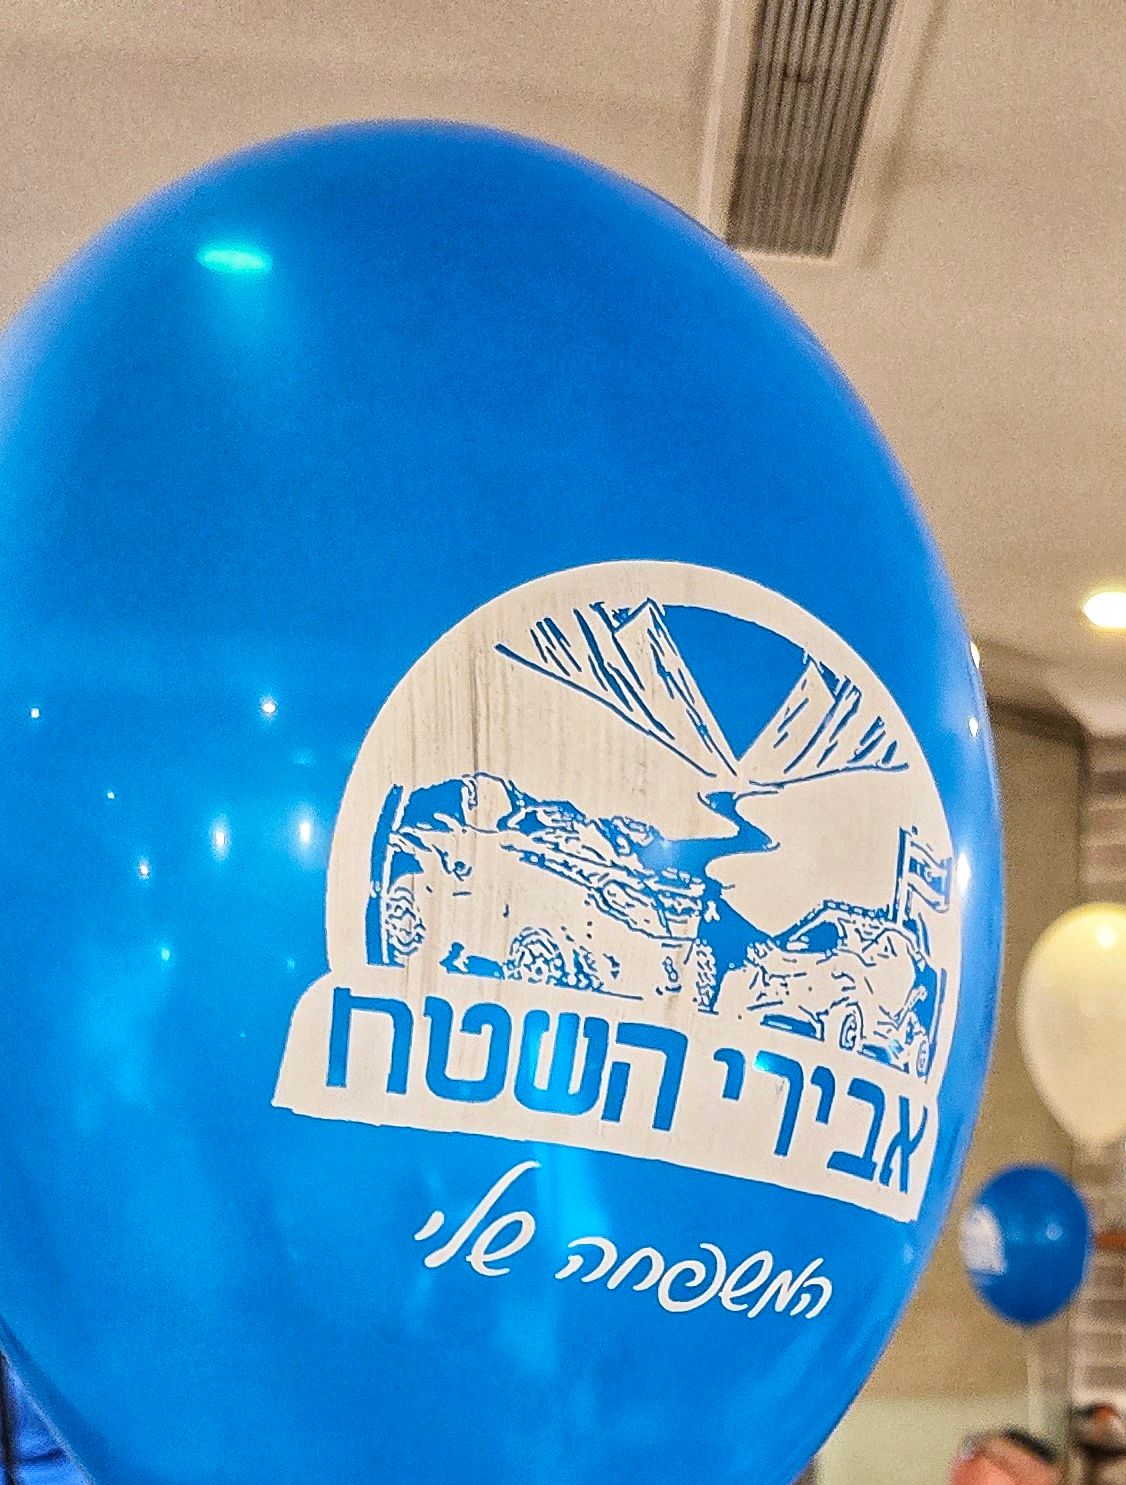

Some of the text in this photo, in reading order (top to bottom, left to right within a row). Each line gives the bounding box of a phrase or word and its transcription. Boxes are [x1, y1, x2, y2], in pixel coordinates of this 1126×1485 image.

[325, 986, 930, 1195] אבירי השטח
[414, 1159, 833, 1320] המשפחה שלי
